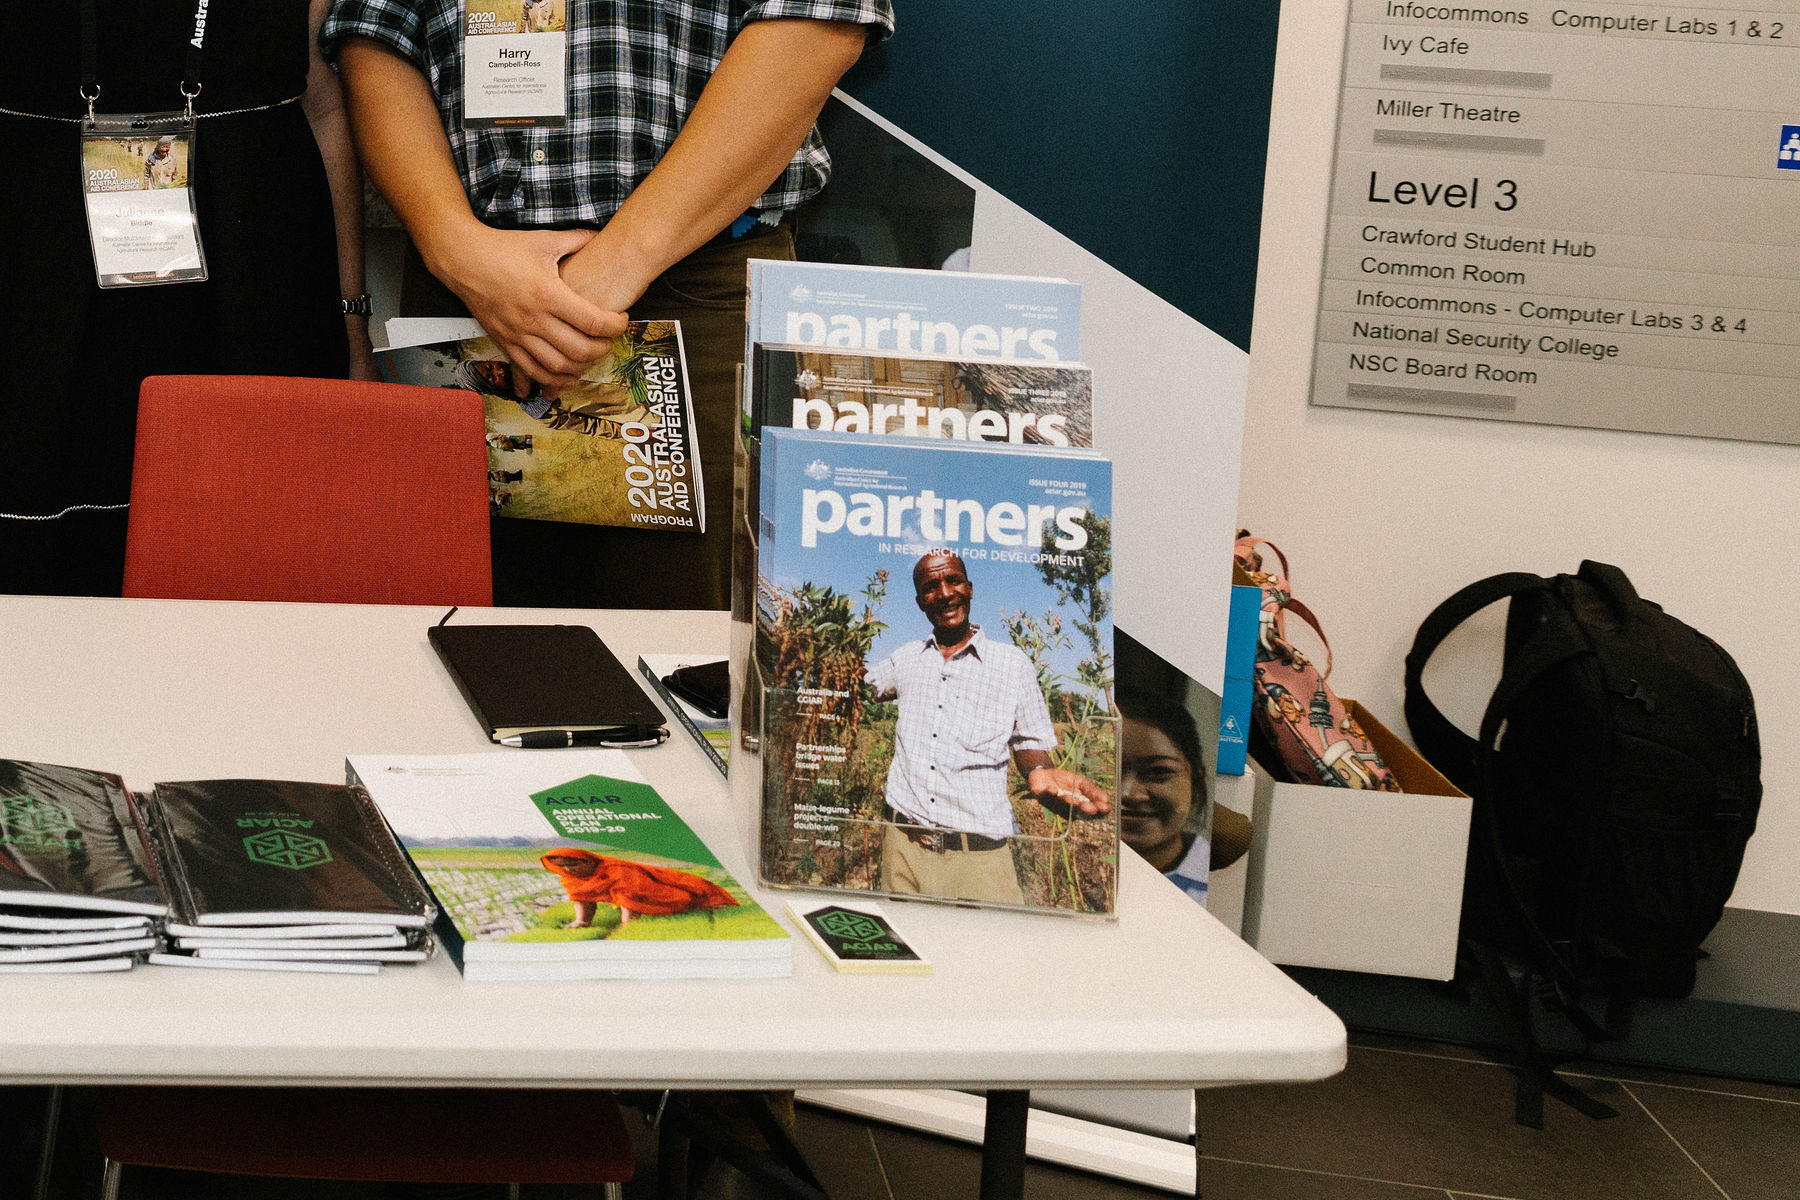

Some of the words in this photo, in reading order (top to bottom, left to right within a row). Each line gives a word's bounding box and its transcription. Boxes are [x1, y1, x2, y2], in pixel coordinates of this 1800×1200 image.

[468, 12, 496, 22] 2020
[1386, 2, 1528, 25] Infocommons
[1551, 10, 1658, 34] Computer
[1666, 16, 1718, 35] Labs
[1728, 19, 1738, 36] 1
[1746, 19, 1764, 37] &
[1769, 21, 1784, 39] 2
[499, 49, 531, 60] Harry
[1383, 35, 1411, 57] Ivy
[1420, 37, 1469, 56] Cafe
[1376, 100, 1432, 118] Miller
[1440, 103, 1521, 123] Theatre
[90, 169, 118, 180] 2020
[1369, 172, 1479, 209] Level
[1494, 180, 1519, 212] 3
[1362, 226, 1457, 248] Crawford
[1465, 233, 1545, 254] Student
[1553, 240, 1596, 258] Hub
[1360, 258, 1455, 278] Common
[1463, 264, 1526, 285] Room
[1356, 290, 1496, 315] Infocommons
[1519, 302, 1625, 327] Computer
[1632, 310, 1683, 330] Labs
[1692, 313, 1704, 330] 3
[1711, 316, 1729, 333] &
[1735, 316, 1747, 334] 4
[787, 311, 1059, 362] partners
[1353, 322, 1439, 344] National
[1447, 330, 1531, 354] Security
[1539, 335, 1619, 360] College
[1350, 353, 1398, 374] NSC
[1405, 357, 1468, 378] Board
[1476, 363, 1537, 384] Room
[660, 357, 685, 477] CONFERENCE
[792, 398, 1069, 447] partners
[643, 357, 675, 510] AUSTRALASIAN
[621, 422, 657, 508] 2020
[672, 481, 690, 511] AID
[1029, 479, 1047, 487] ISSUE
[1049, 480, 1067, 488] FOUR
[1069, 481, 1087, 489] 2019
[630, 514, 693, 526] PROGRAM
[801, 489, 1088, 550] partners
[879, 544, 891, 553] IN
[894, 544, 958, 557] RESEARCH
[962, 549, 986, 560] FOR
[991, 550, 1084, 566] DEVELOPMENT
[796, 743, 846, 754] Partnerships
[546, 796, 623, 805] ACIAR
[236, 818, 314, 828] ACIAR
[555, 813, 662, 821] OPERATIONAL
[842, 942, 898, 951] ACIAR
